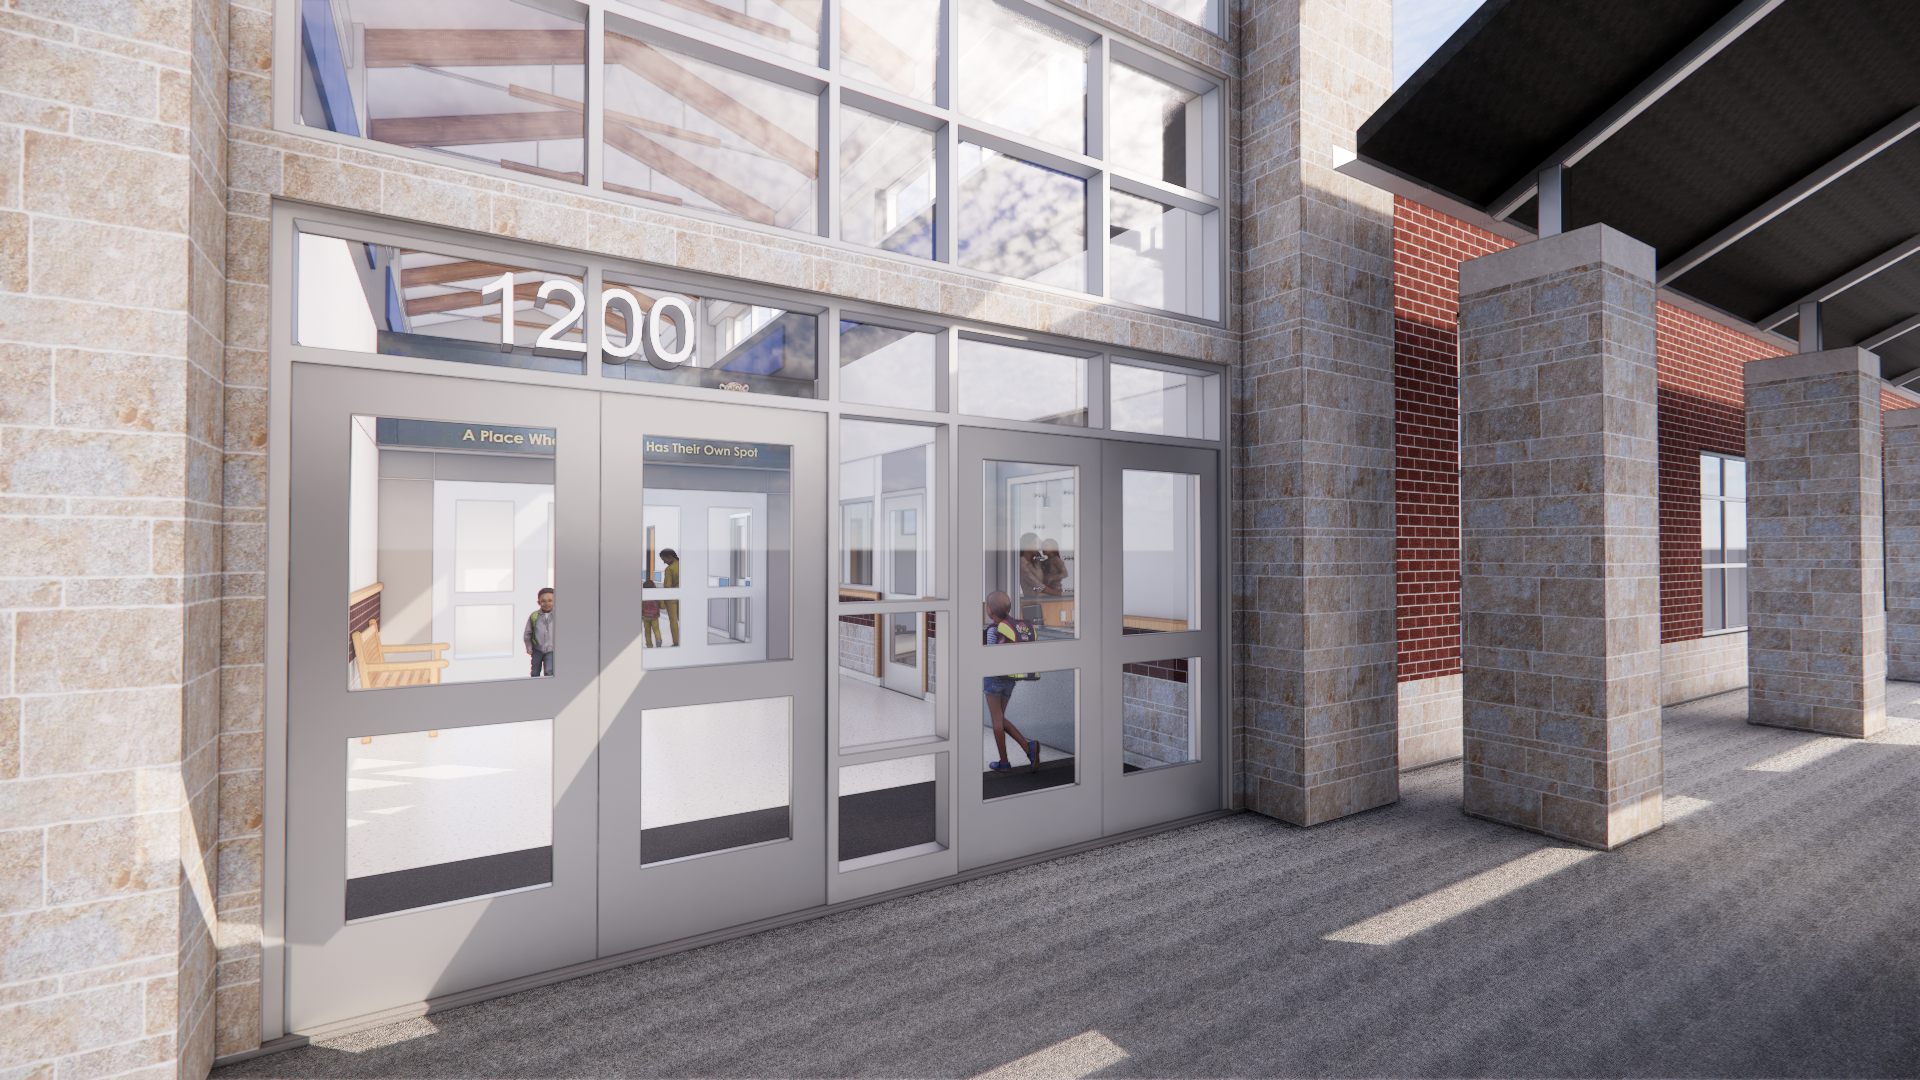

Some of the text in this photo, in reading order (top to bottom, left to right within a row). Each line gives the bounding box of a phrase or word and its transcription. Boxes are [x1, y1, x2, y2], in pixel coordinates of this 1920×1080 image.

[482, 271, 695, 367] 1200
[462, 429, 476, 441] A
[480, 430, 525, 444] Place
[646, 441, 670, 453] Has
[672, 442, 701, 455] Their
[704, 445, 731, 457] Own
[733, 446, 759, 459] Spot
